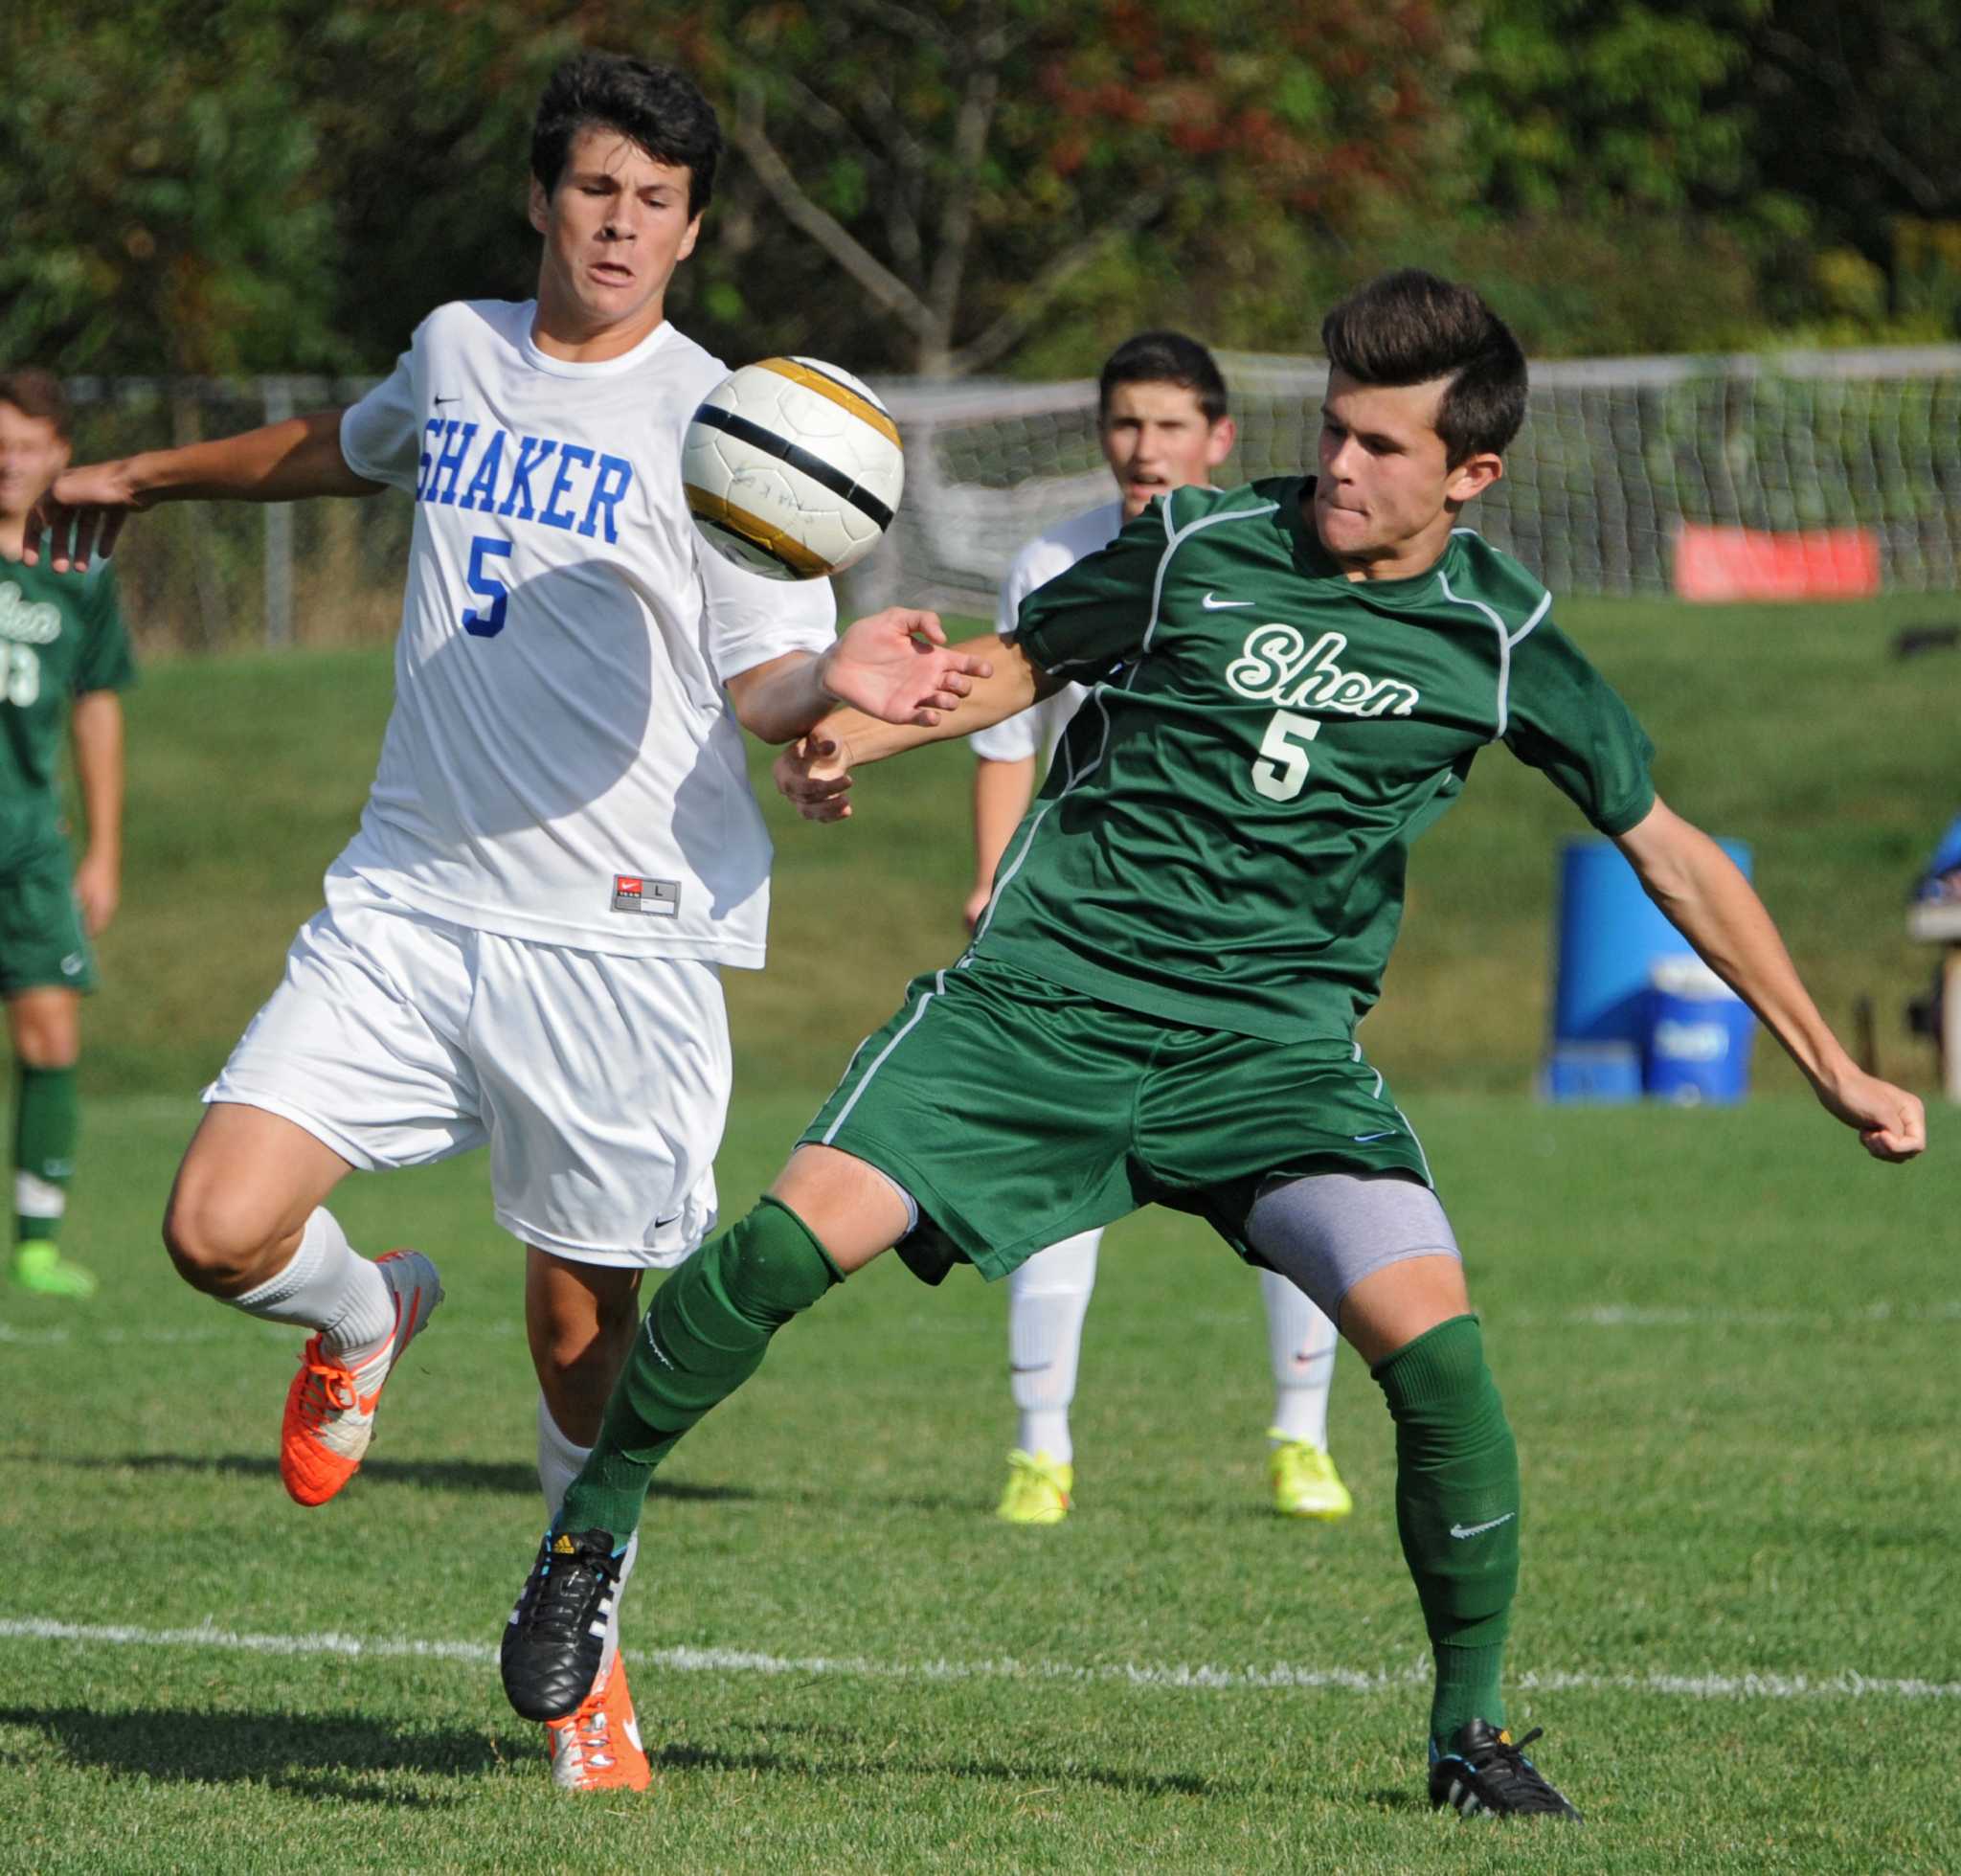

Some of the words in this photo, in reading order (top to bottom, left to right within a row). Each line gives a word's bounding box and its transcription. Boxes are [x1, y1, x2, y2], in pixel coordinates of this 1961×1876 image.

[416, 418, 633, 545] SHAKER
[462, 535, 512, 638] 5
[1226, 623, 1419, 716] Shen
[1251, 709, 1310, 802] 5
[654, 884, 664, 897] L
